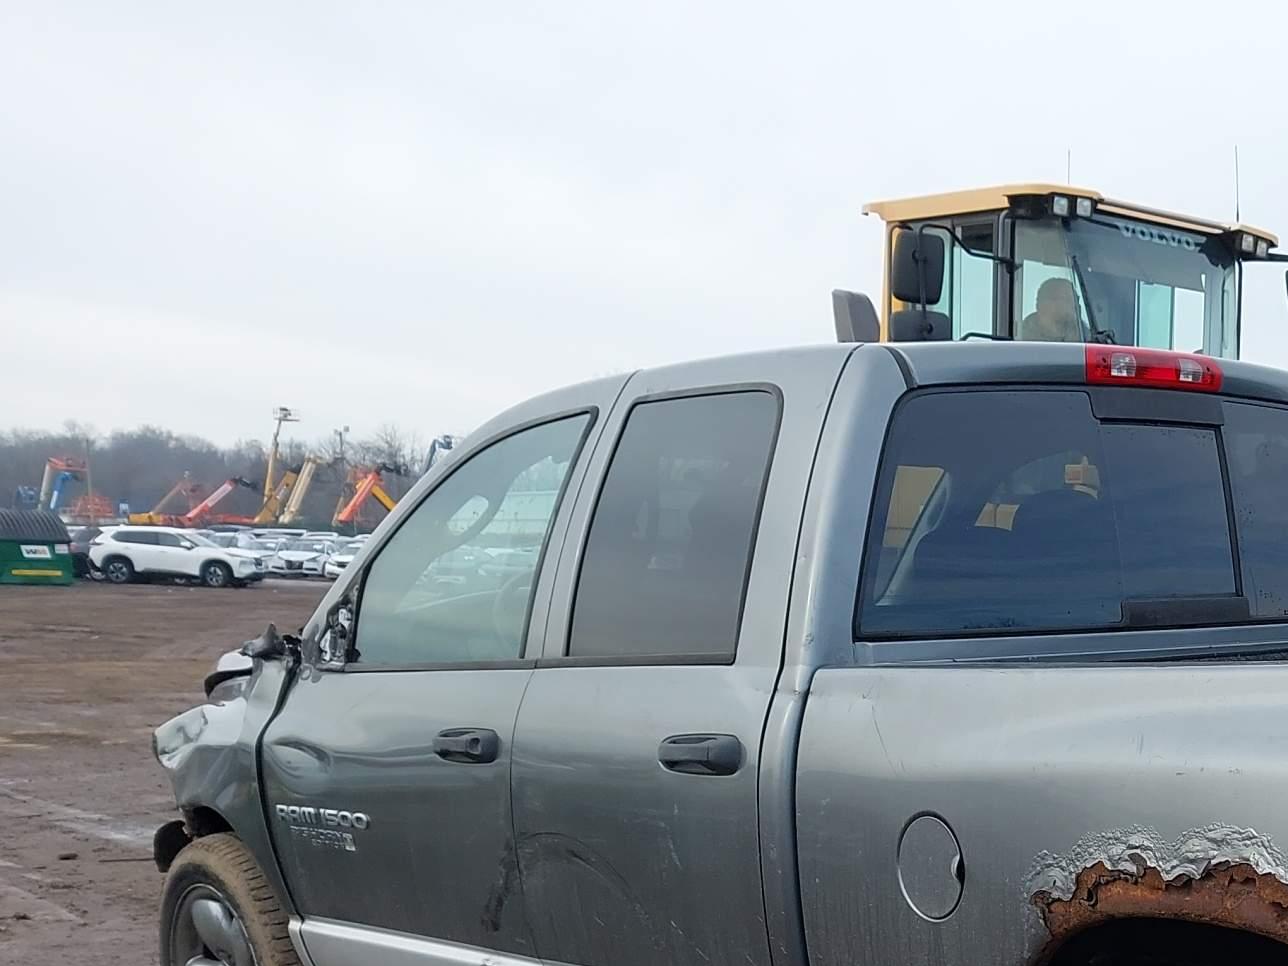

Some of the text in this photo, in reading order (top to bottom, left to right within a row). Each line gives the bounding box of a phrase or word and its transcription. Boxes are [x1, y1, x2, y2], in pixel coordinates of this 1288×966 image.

[1121, 223, 1196, 251] VOLVO
[275, 803, 370, 830] RAM 1500
